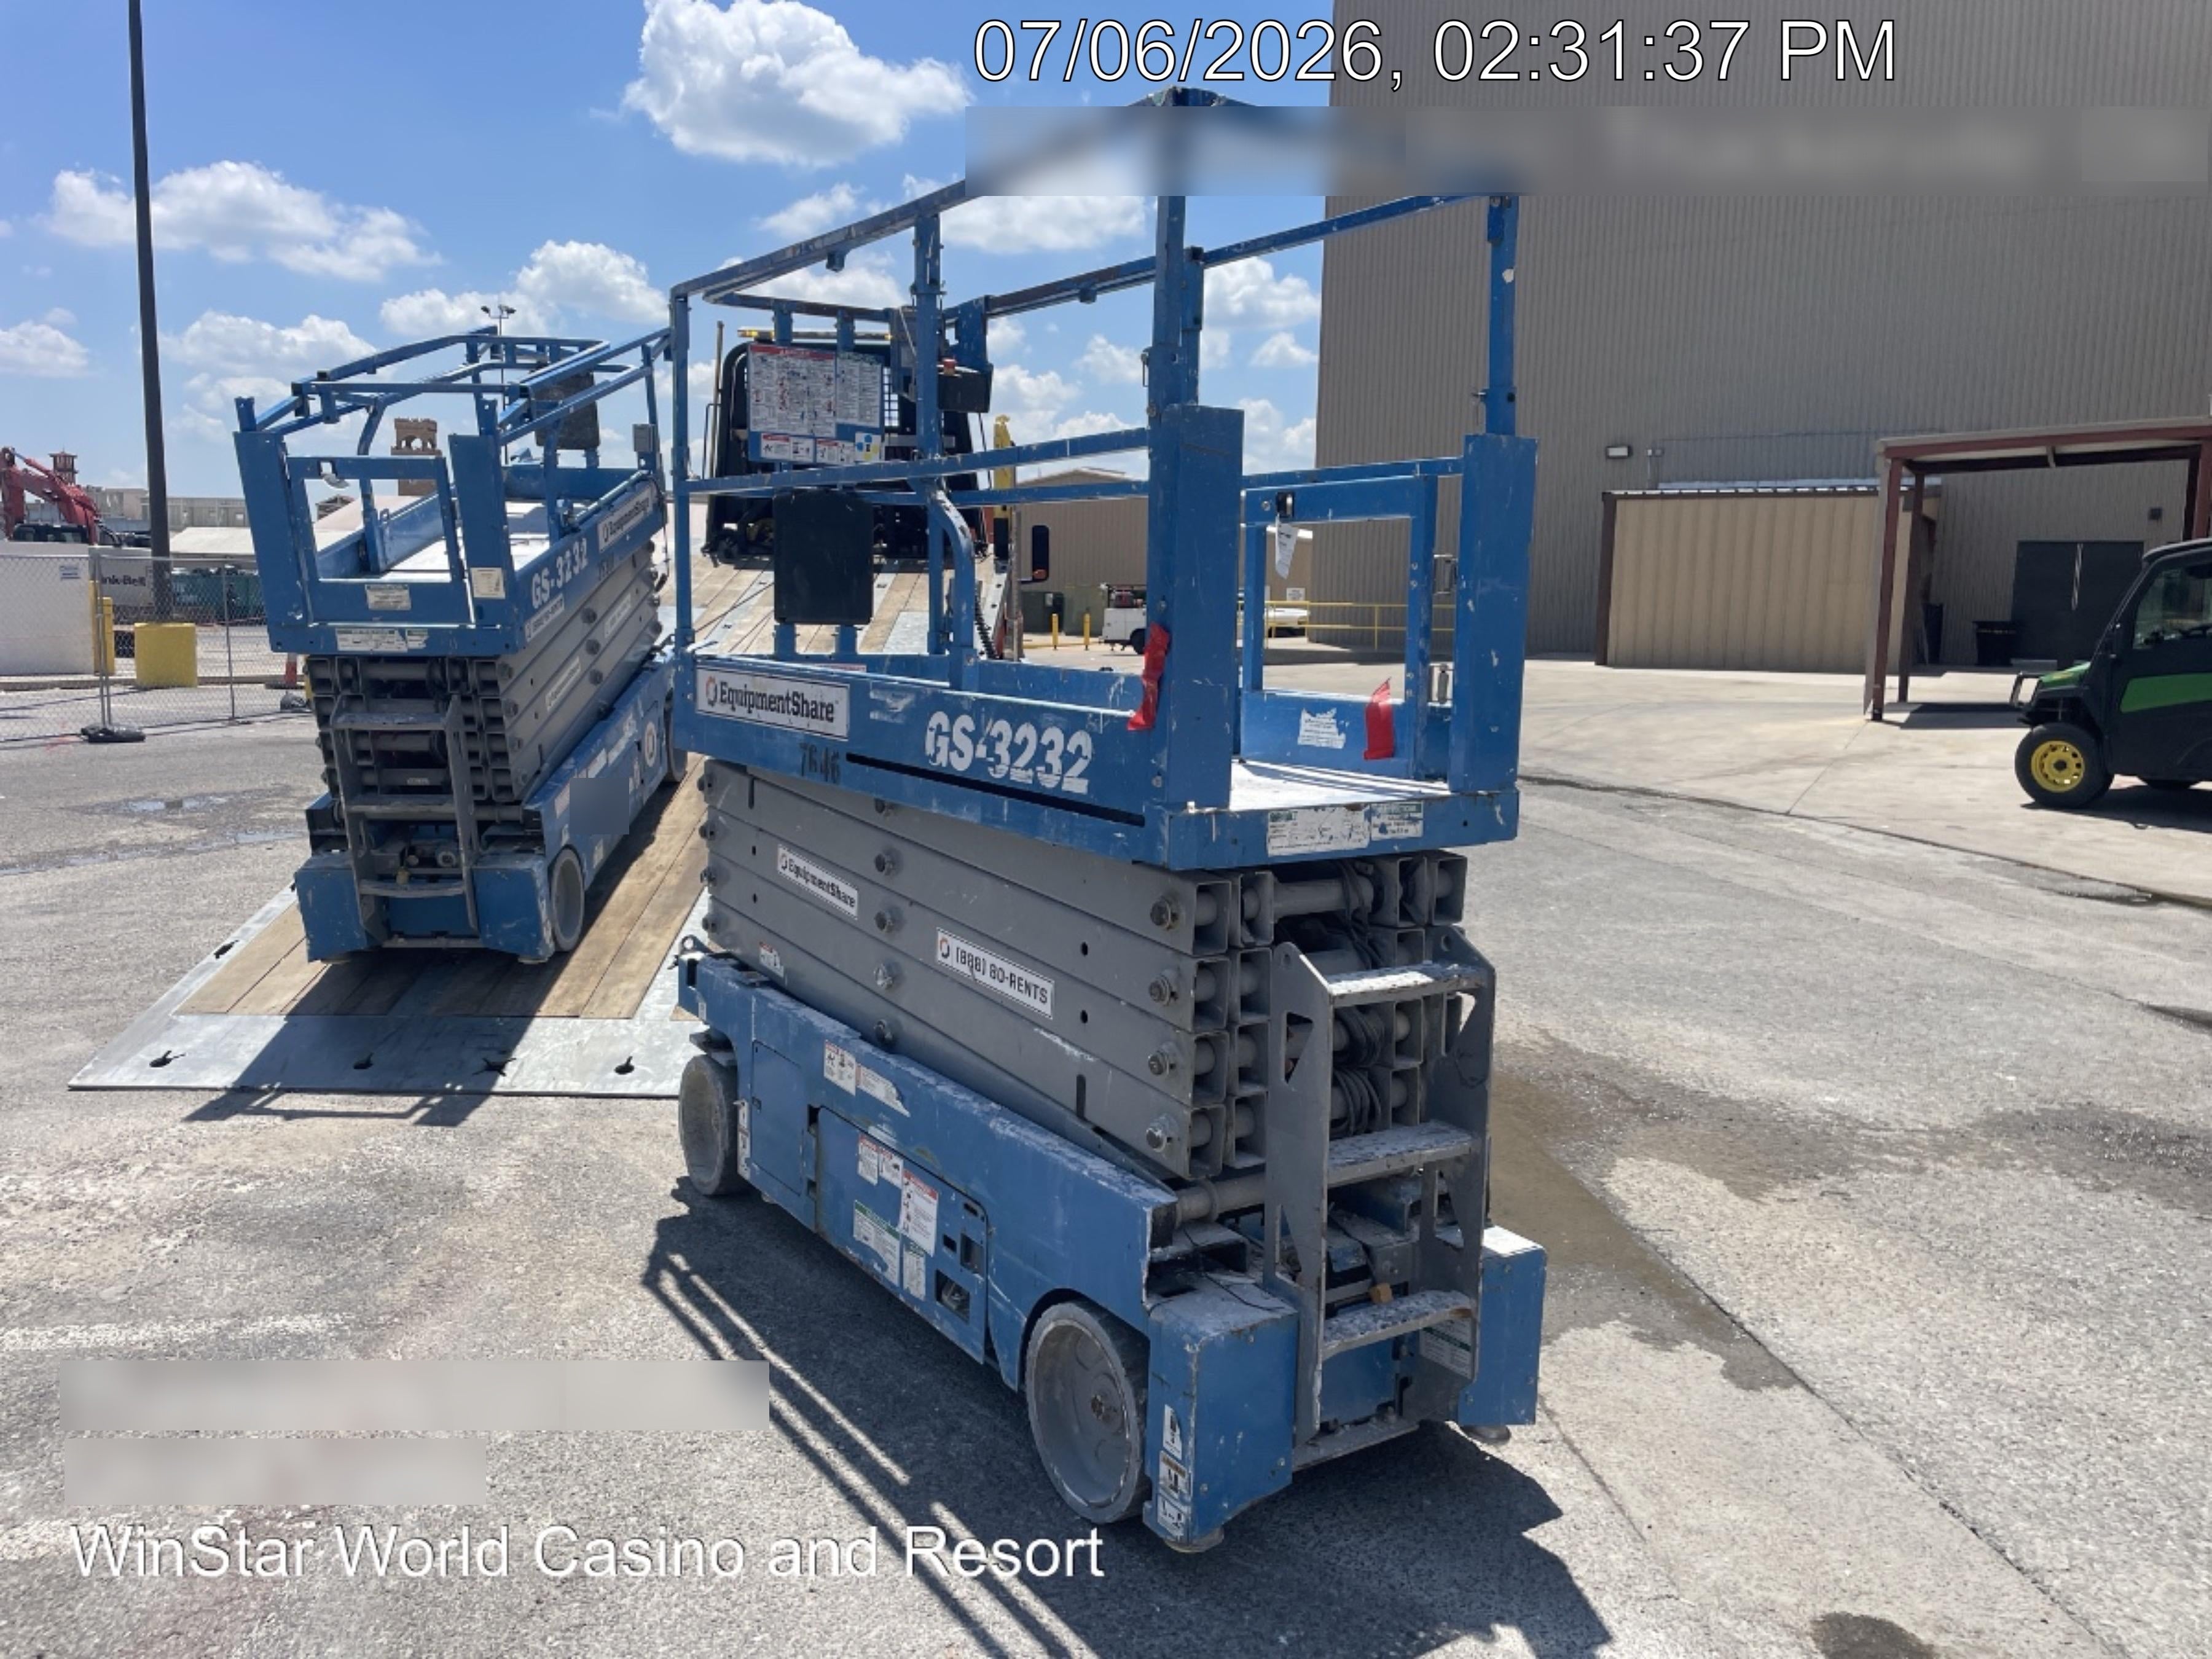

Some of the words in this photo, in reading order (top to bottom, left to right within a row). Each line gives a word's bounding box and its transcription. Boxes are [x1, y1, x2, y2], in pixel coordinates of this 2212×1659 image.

[532, 538, 588, 609] GS-3232
[719, 681, 834, 723] EquipmentShare
[925, 711, 1093, 794] GS-3232
